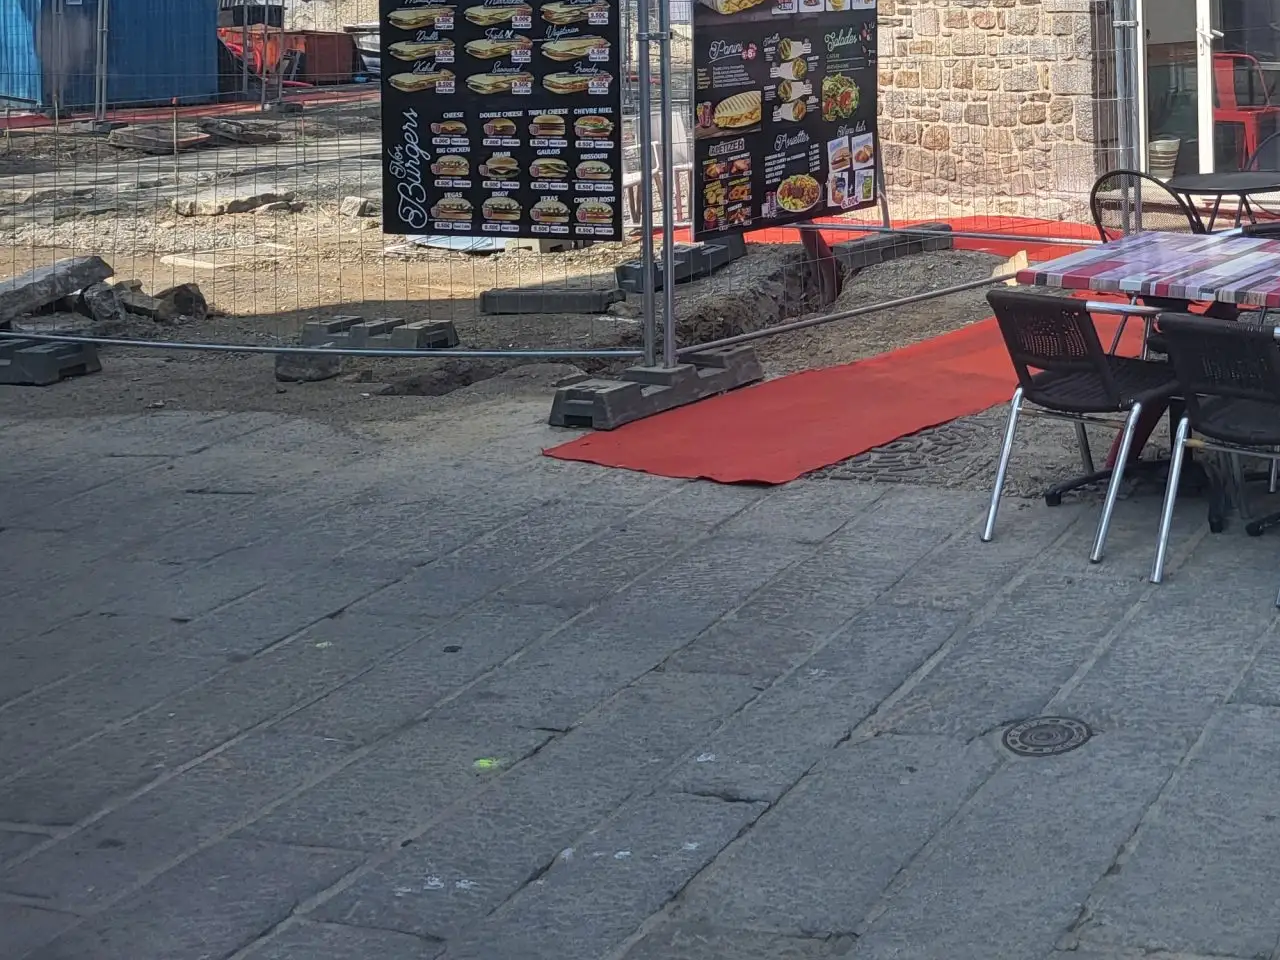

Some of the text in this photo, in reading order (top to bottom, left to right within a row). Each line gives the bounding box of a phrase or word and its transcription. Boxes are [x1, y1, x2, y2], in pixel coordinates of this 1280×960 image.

[824, 28, 857, 51] Salades
[387, 144, 406, 179] Nos
[397, 108, 430, 229] Burgers
